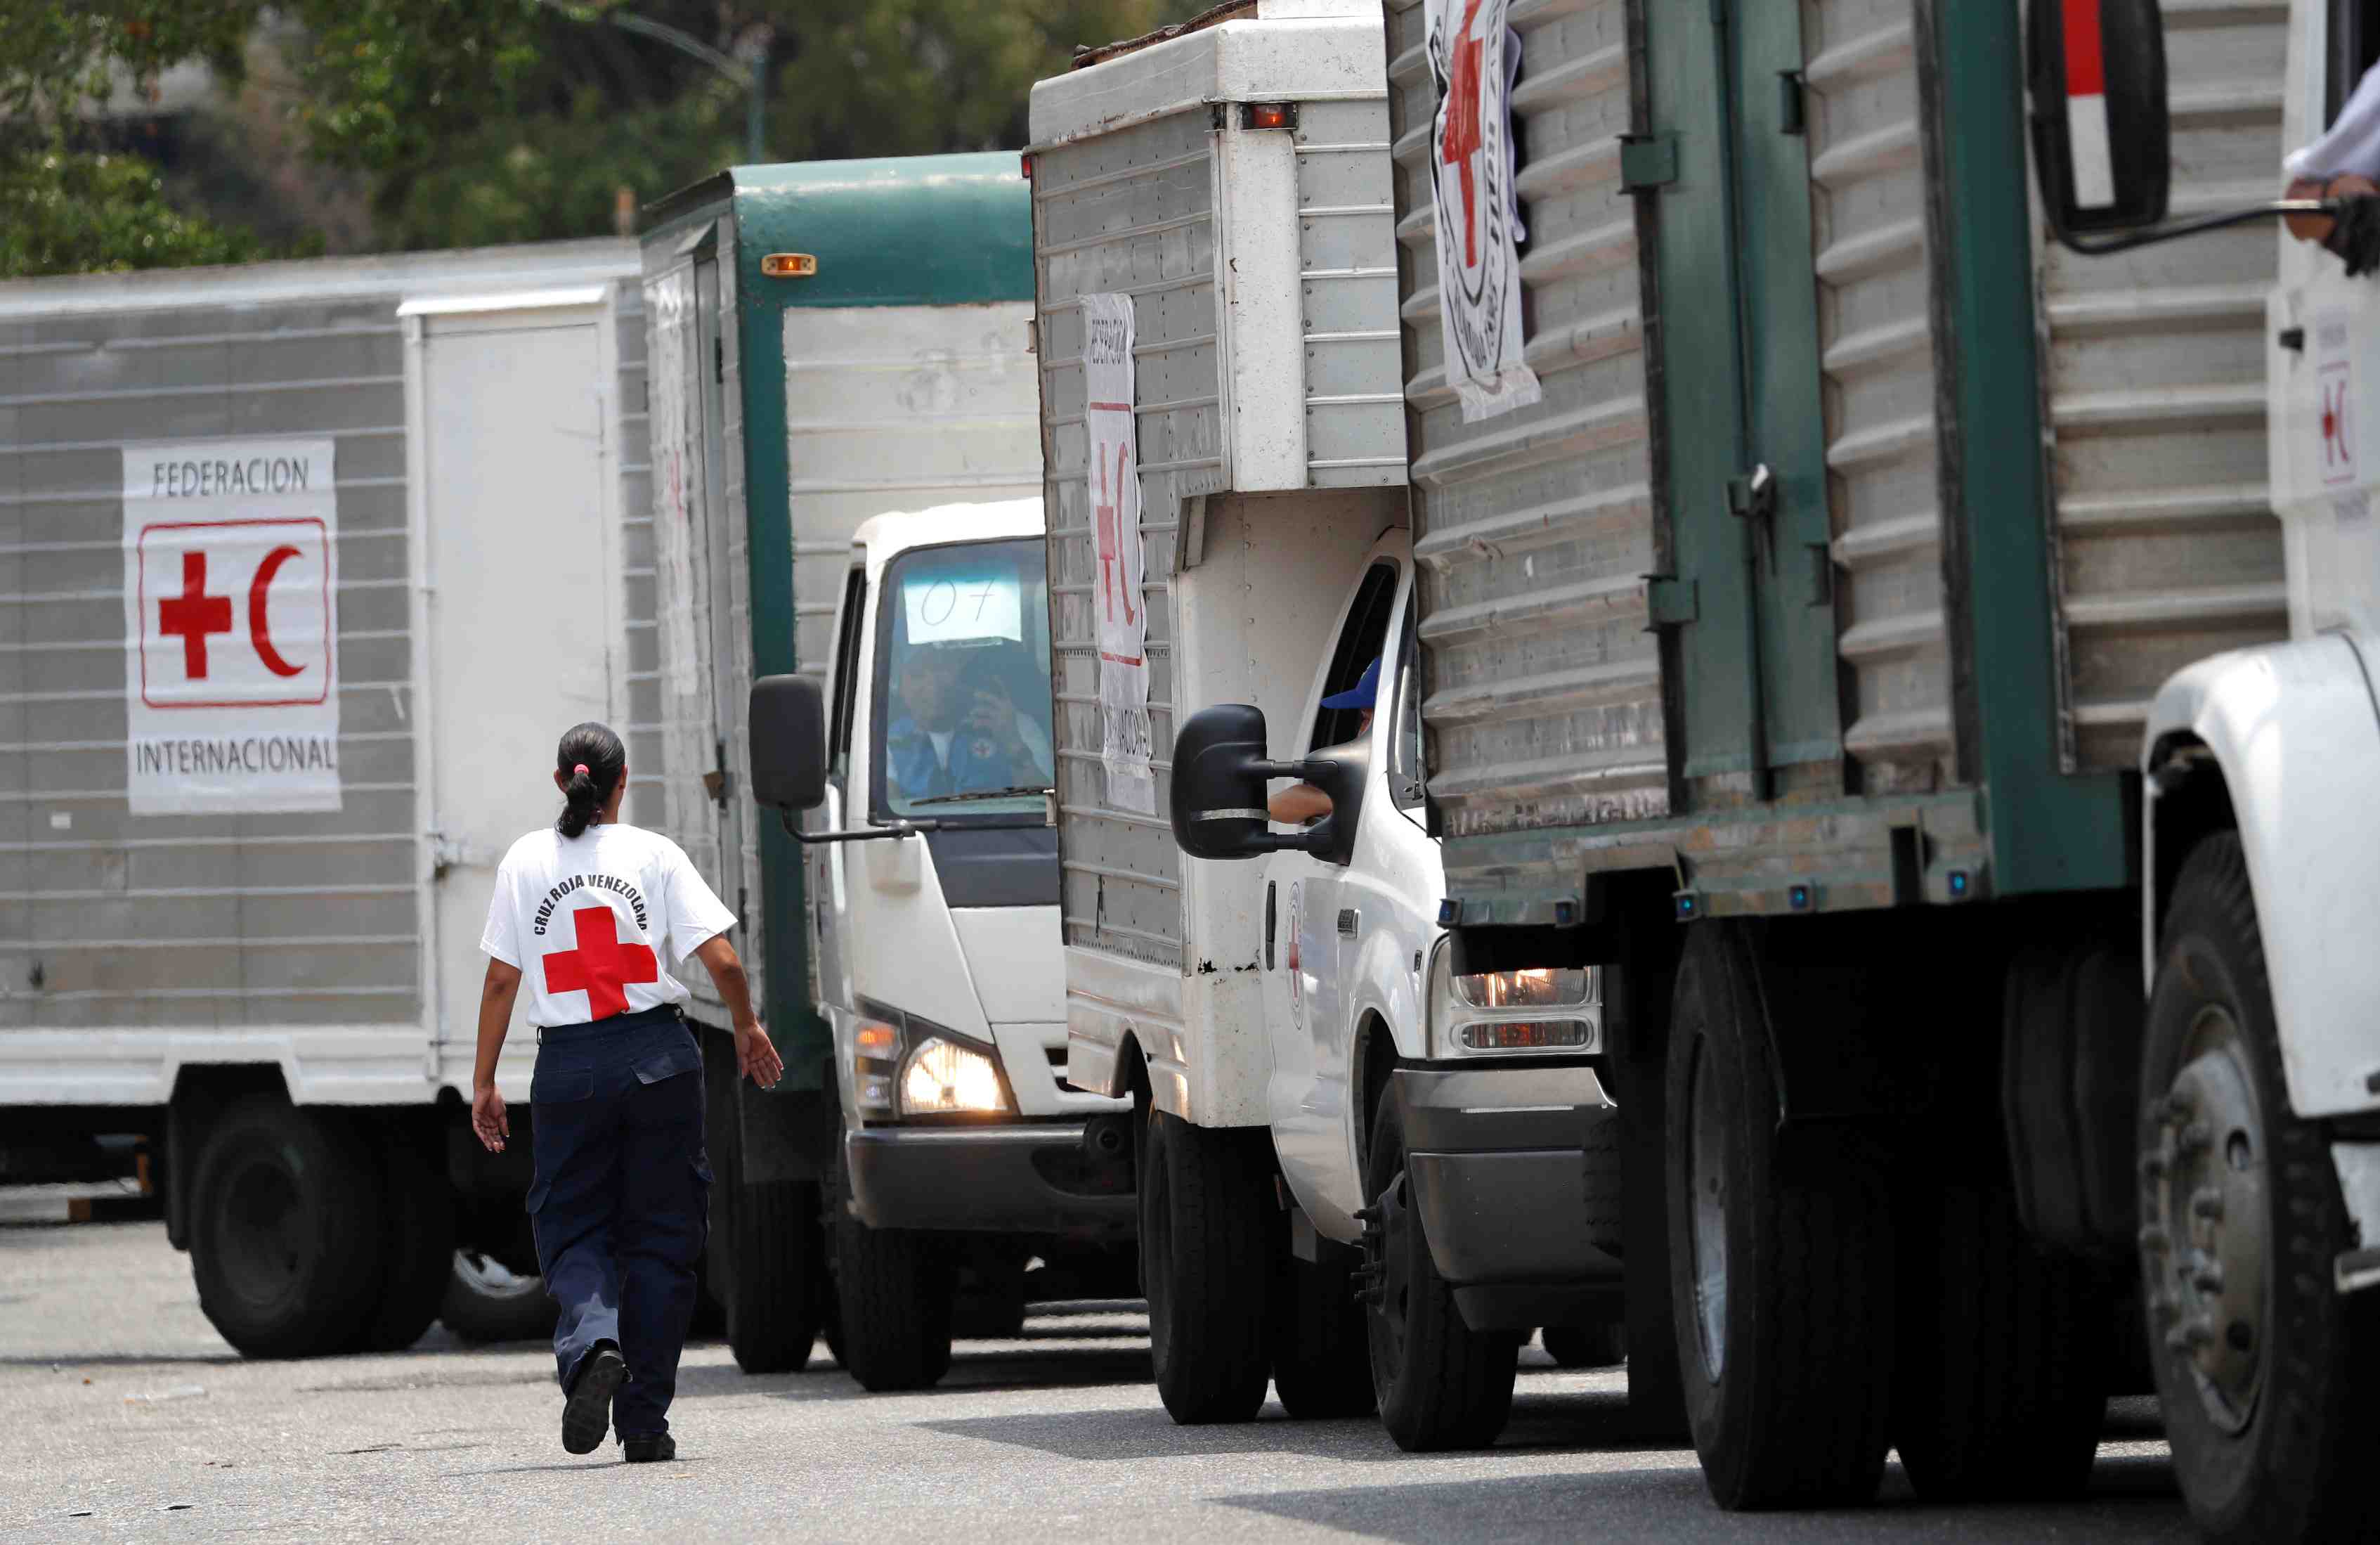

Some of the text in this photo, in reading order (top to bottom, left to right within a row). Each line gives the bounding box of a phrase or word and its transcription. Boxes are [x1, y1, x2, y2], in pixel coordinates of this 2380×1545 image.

[152, 457, 310, 498] FEDERACION
[136, 738, 337, 776] INTERNACIONAL
[534, 896, 556, 936] CRUZ
[550, 874, 585, 903] ROJA
